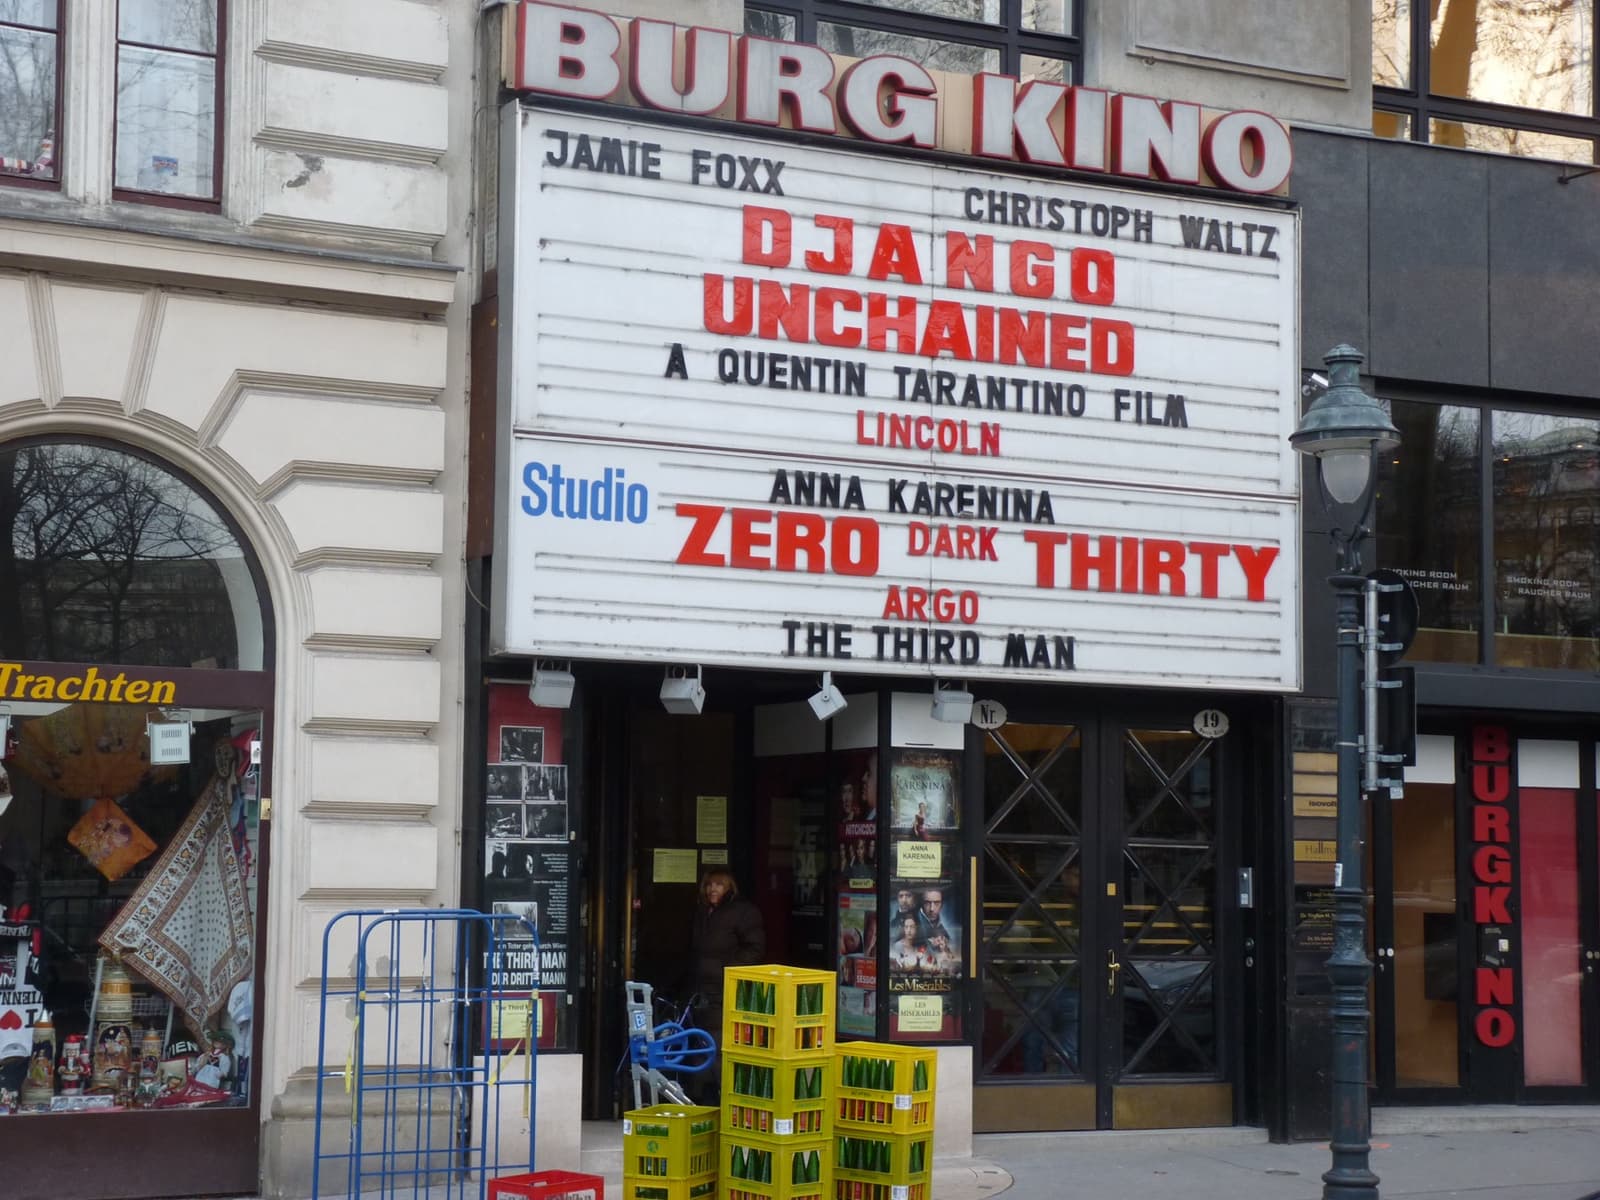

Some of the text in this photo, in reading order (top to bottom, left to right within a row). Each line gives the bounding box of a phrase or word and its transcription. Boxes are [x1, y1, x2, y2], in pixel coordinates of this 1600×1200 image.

[514, 0, 1293, 194] BURG KINO
[546, 129, 785, 196] JAMIE FOXX
[965, 187, 1279, 259] CHRISTOPH WALTZ
[743, 204, 1115, 306] DJANGO
[703, 273, 1135, 377] UNCHAINED
[664, 343, 1188, 428] A QUENTIN TARANTINO FILM
[857, 409, 1001, 458] LINCOLN
[521, 461, 648, 525] Studio
[769, 468, 1056, 525] ANNA KARENINA
[675, 502, 1280, 602] ZERO DARK THIRTY
[1391, 568, 1457, 580] OKING ROOM
[1442, 582, 1469, 591] RAUM
[1506, 575, 1580, 588] SMOKING ROOM
[1518, 587, 1592, 600] RAUCHER RAUM
[883, 585, 979, 625] ARGO
[782, 620, 1076, 671] THE THIRD MAN
[0, 662, 176, 705] Trachten
[980, 704, 998, 724] Nr.
[1203, 711, 1220, 728] 19
[902, 853, 936, 861] KARENINA
[511, 972, 540, 985] DRITT
[541, 972, 567, 985] MANN
[542, 952, 567, 970] MAN
[889, 978, 904, 991] Les
